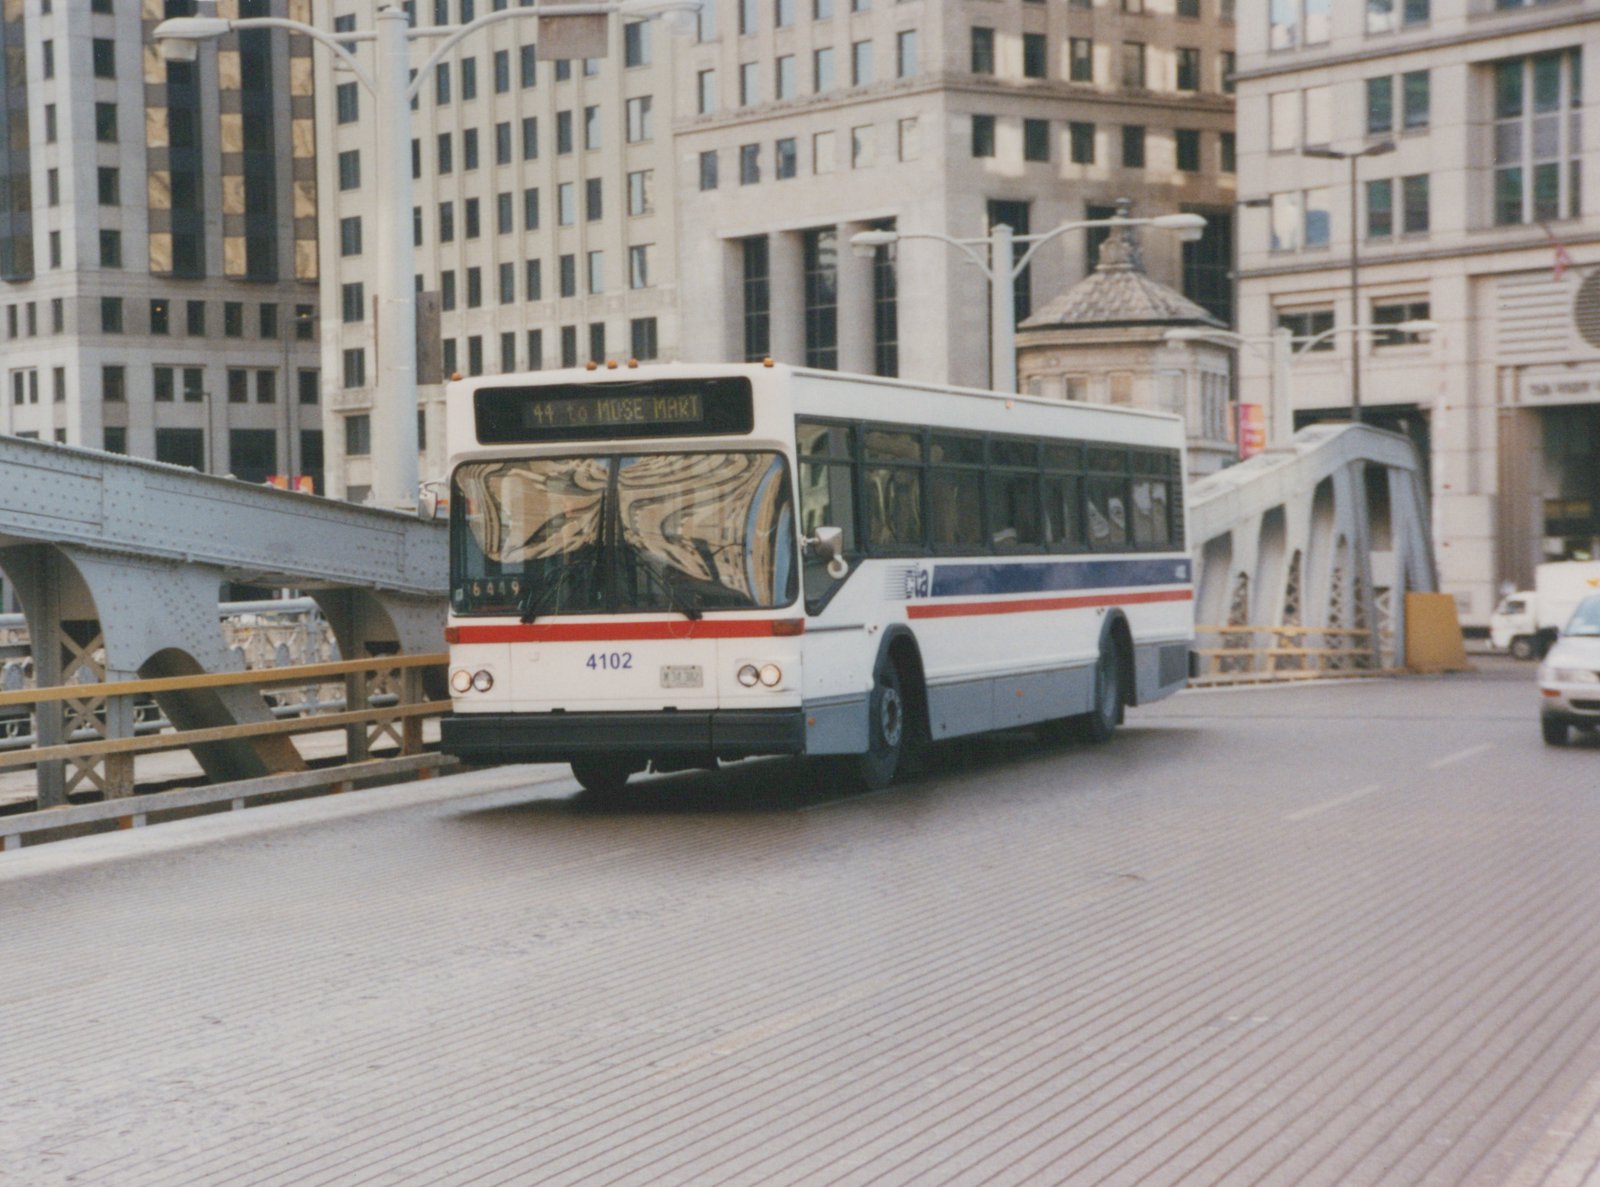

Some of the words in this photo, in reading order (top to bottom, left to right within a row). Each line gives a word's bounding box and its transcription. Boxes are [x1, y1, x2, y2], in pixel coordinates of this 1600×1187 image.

[532, 402, 555, 424] 44
[653, 395, 699, 419] MART
[586, 652, 633, 670] 4102
